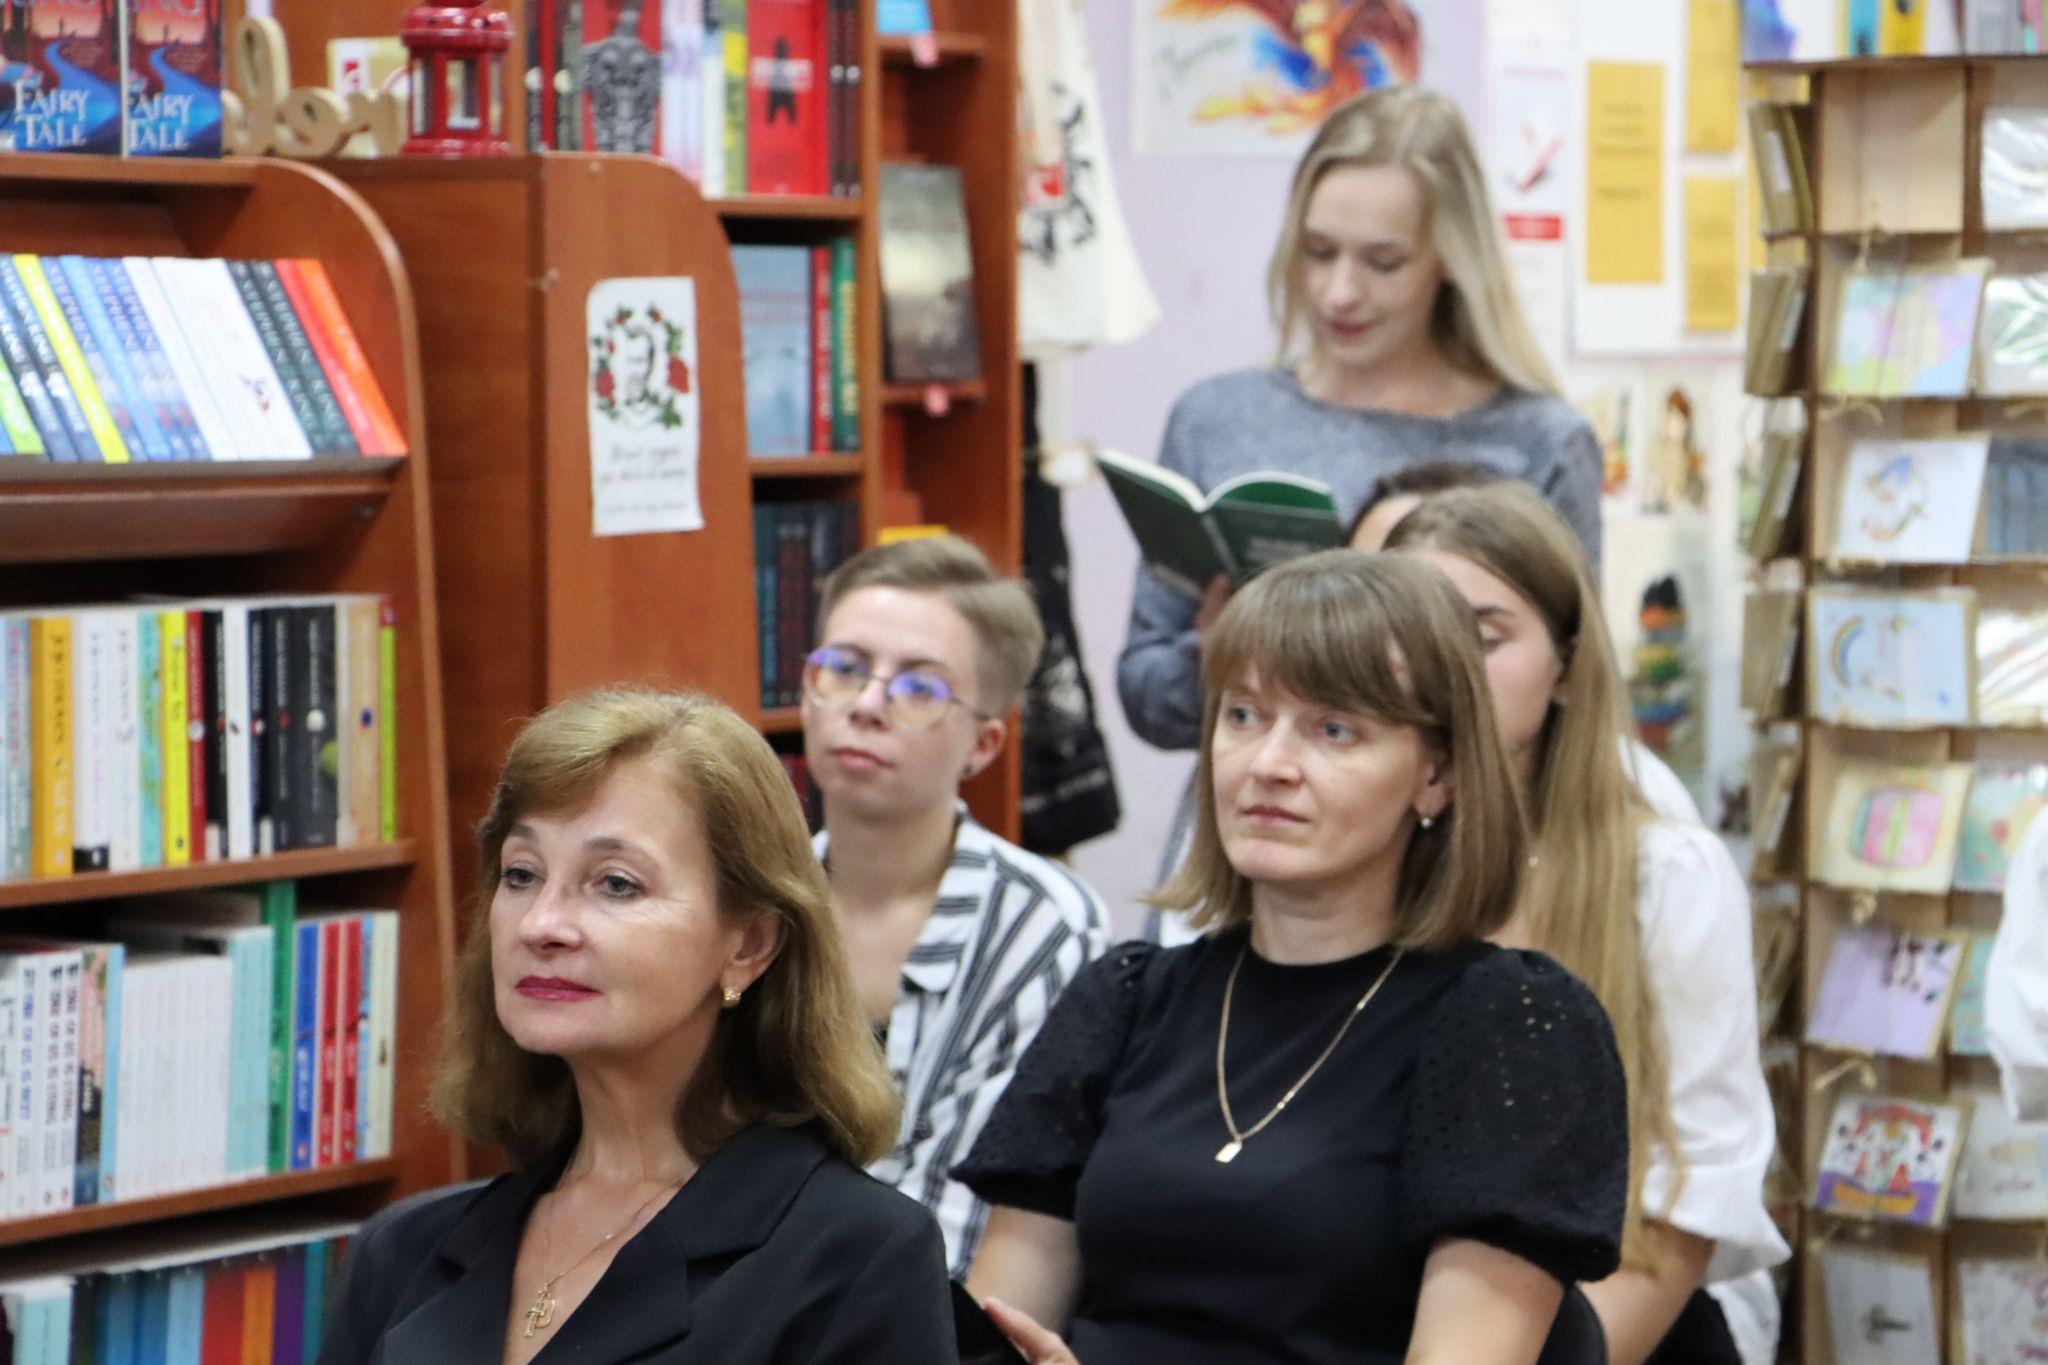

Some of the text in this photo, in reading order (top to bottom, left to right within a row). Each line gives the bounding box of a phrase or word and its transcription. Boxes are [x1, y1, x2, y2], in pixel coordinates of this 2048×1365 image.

[15, 79, 90, 122] FAIRY
[128, 94, 195, 128] AIRY
[15, 112, 88, 147] TALE
[243, 278, 319, 430] STEPHEN KING
[267, 278, 343, 430] STEPHEN KING
